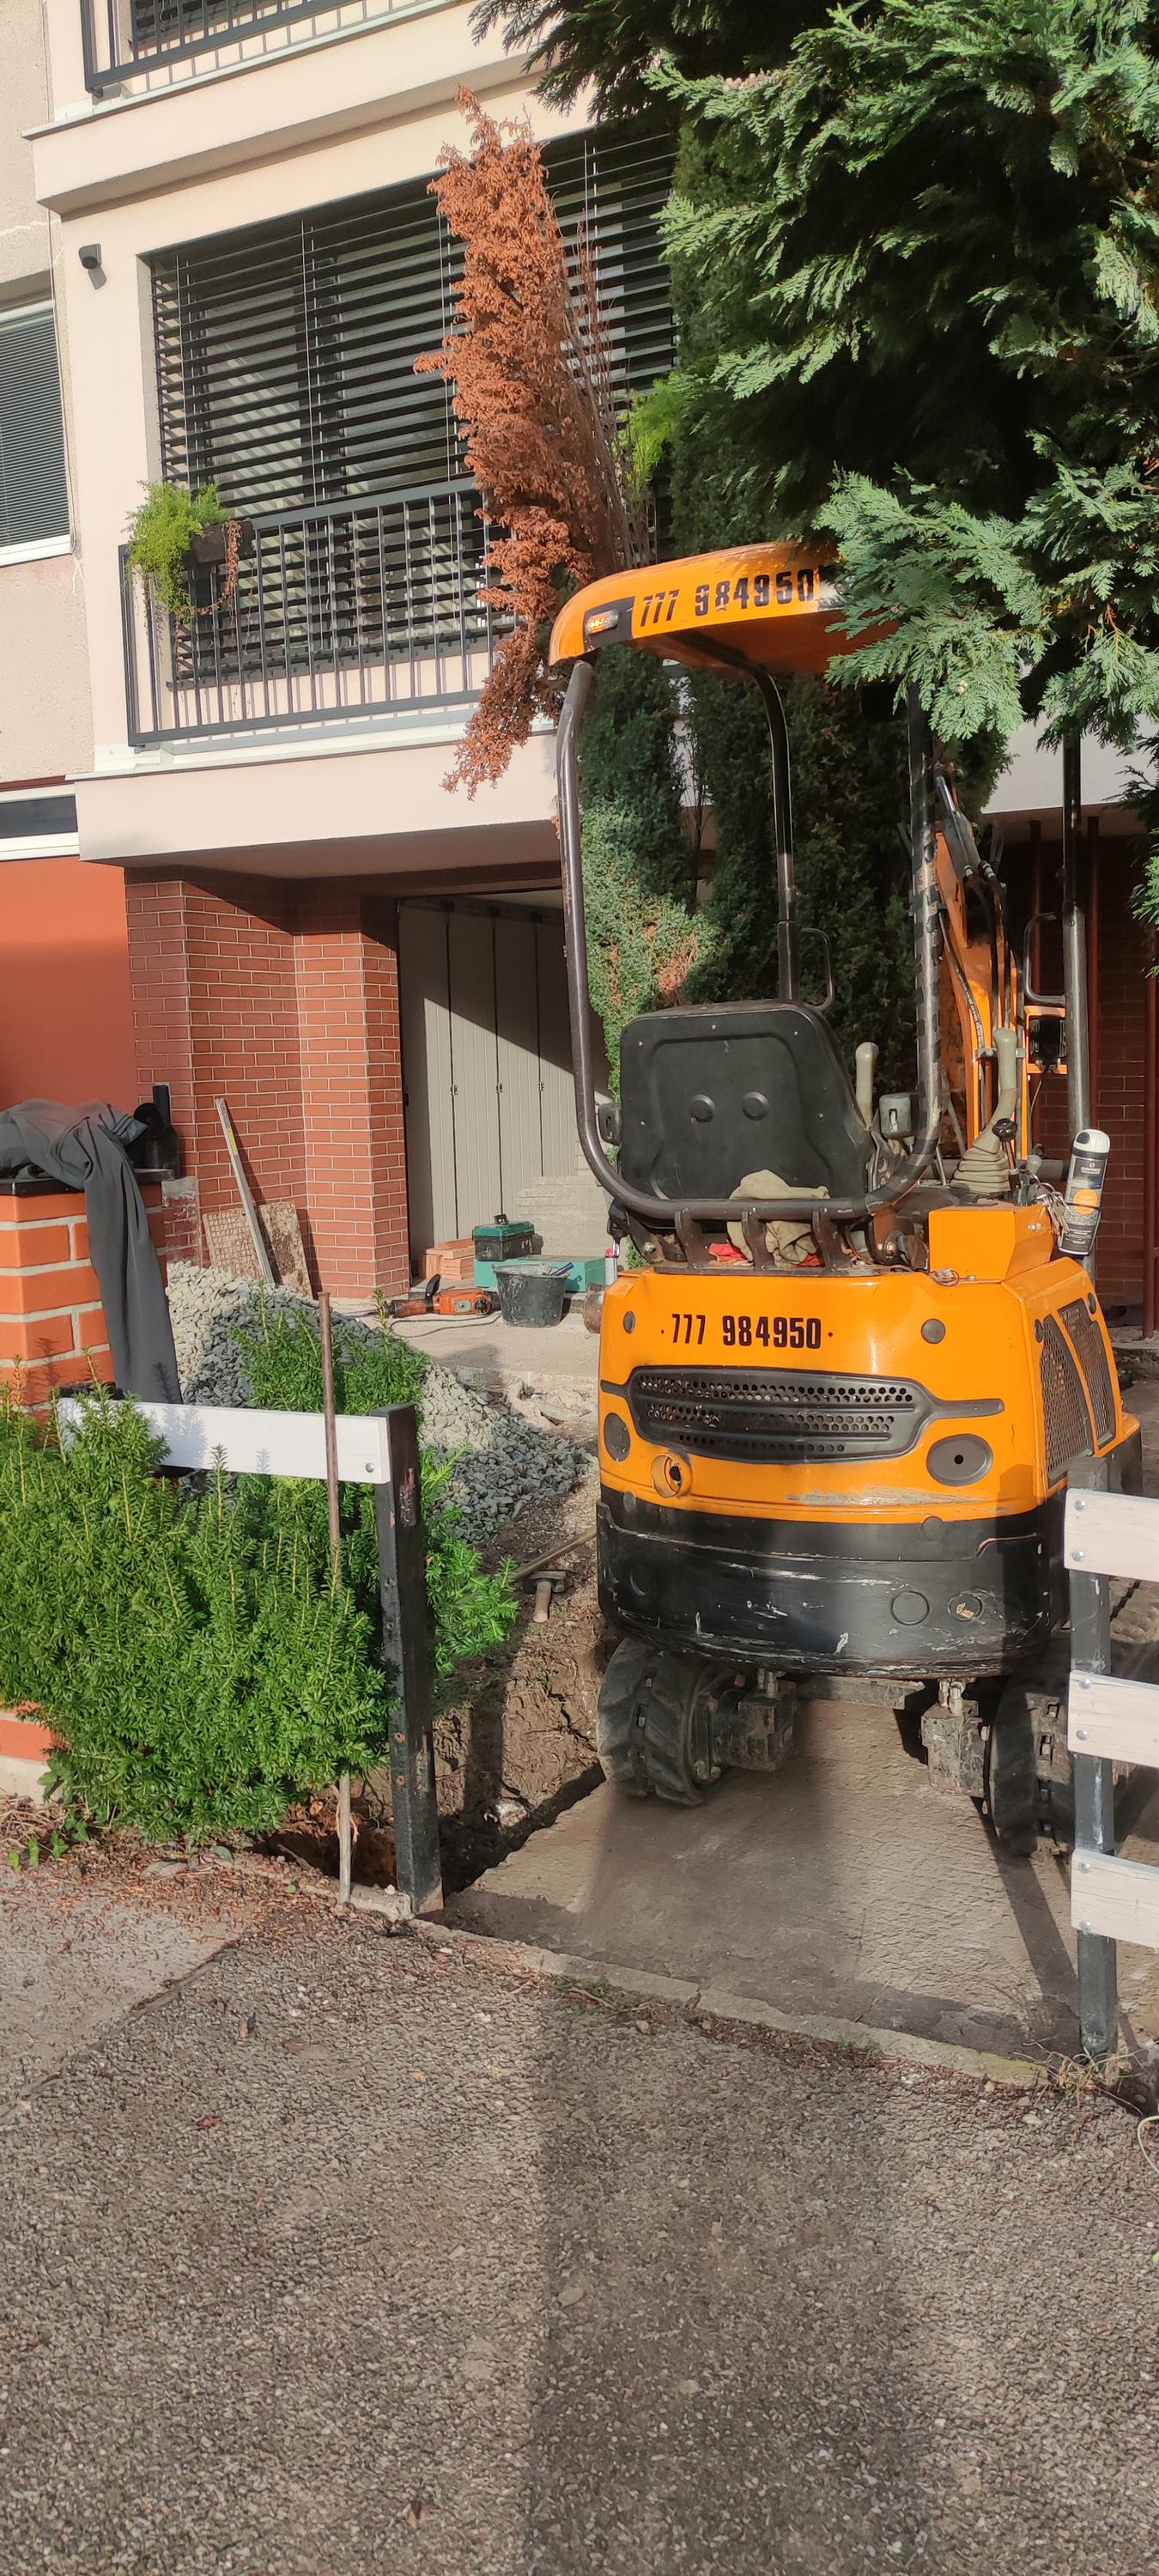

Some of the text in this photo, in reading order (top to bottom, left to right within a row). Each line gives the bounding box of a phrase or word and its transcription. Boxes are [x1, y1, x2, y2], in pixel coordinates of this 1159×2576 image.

[640, 569, 814, 627] 777 984950
[671, 1314, 822, 1349] 777 984950
